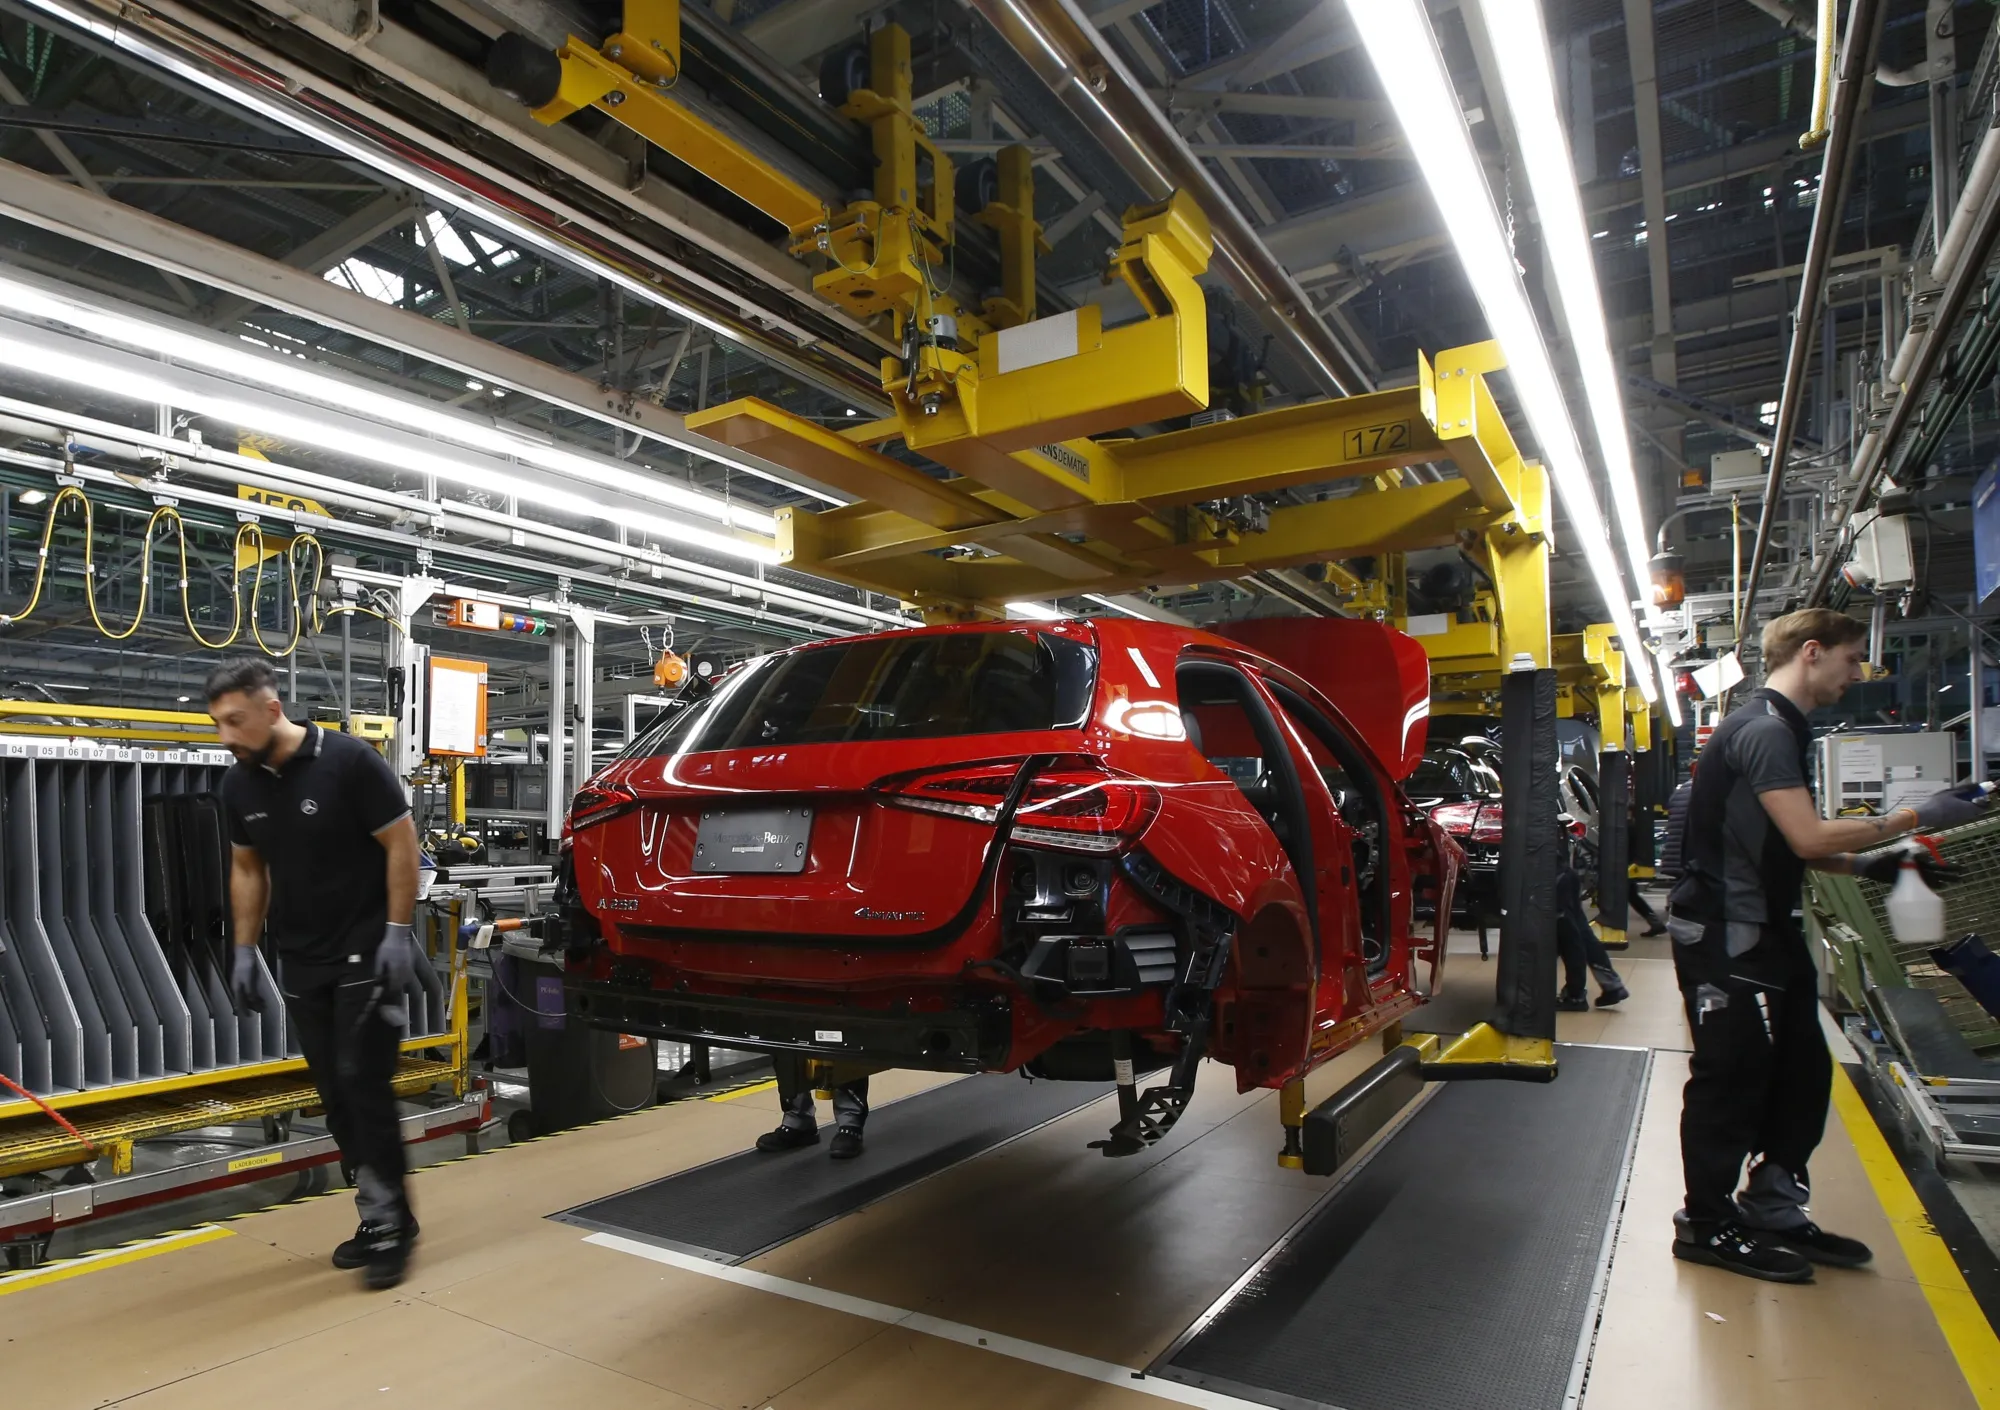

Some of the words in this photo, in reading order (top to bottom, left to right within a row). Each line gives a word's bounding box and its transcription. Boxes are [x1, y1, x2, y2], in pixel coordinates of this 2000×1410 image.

[1351, 424, 1407, 455] 172
[11, 745, 23, 754] 04
[42, 747, 53, 755] 05
[68, 748, 79, 756] 06
[93, 749, 104, 757] 07
[118, 750, 129, 758] 08
[144, 751, 155, 760] 09
[168, 752, 178, 760] 10
[191, 753, 200, 761] 11
[213, 754, 223, 762] 12
[596, 898, 608, 909] A
[234, 1158, 268, 1169] LADEBODEN
